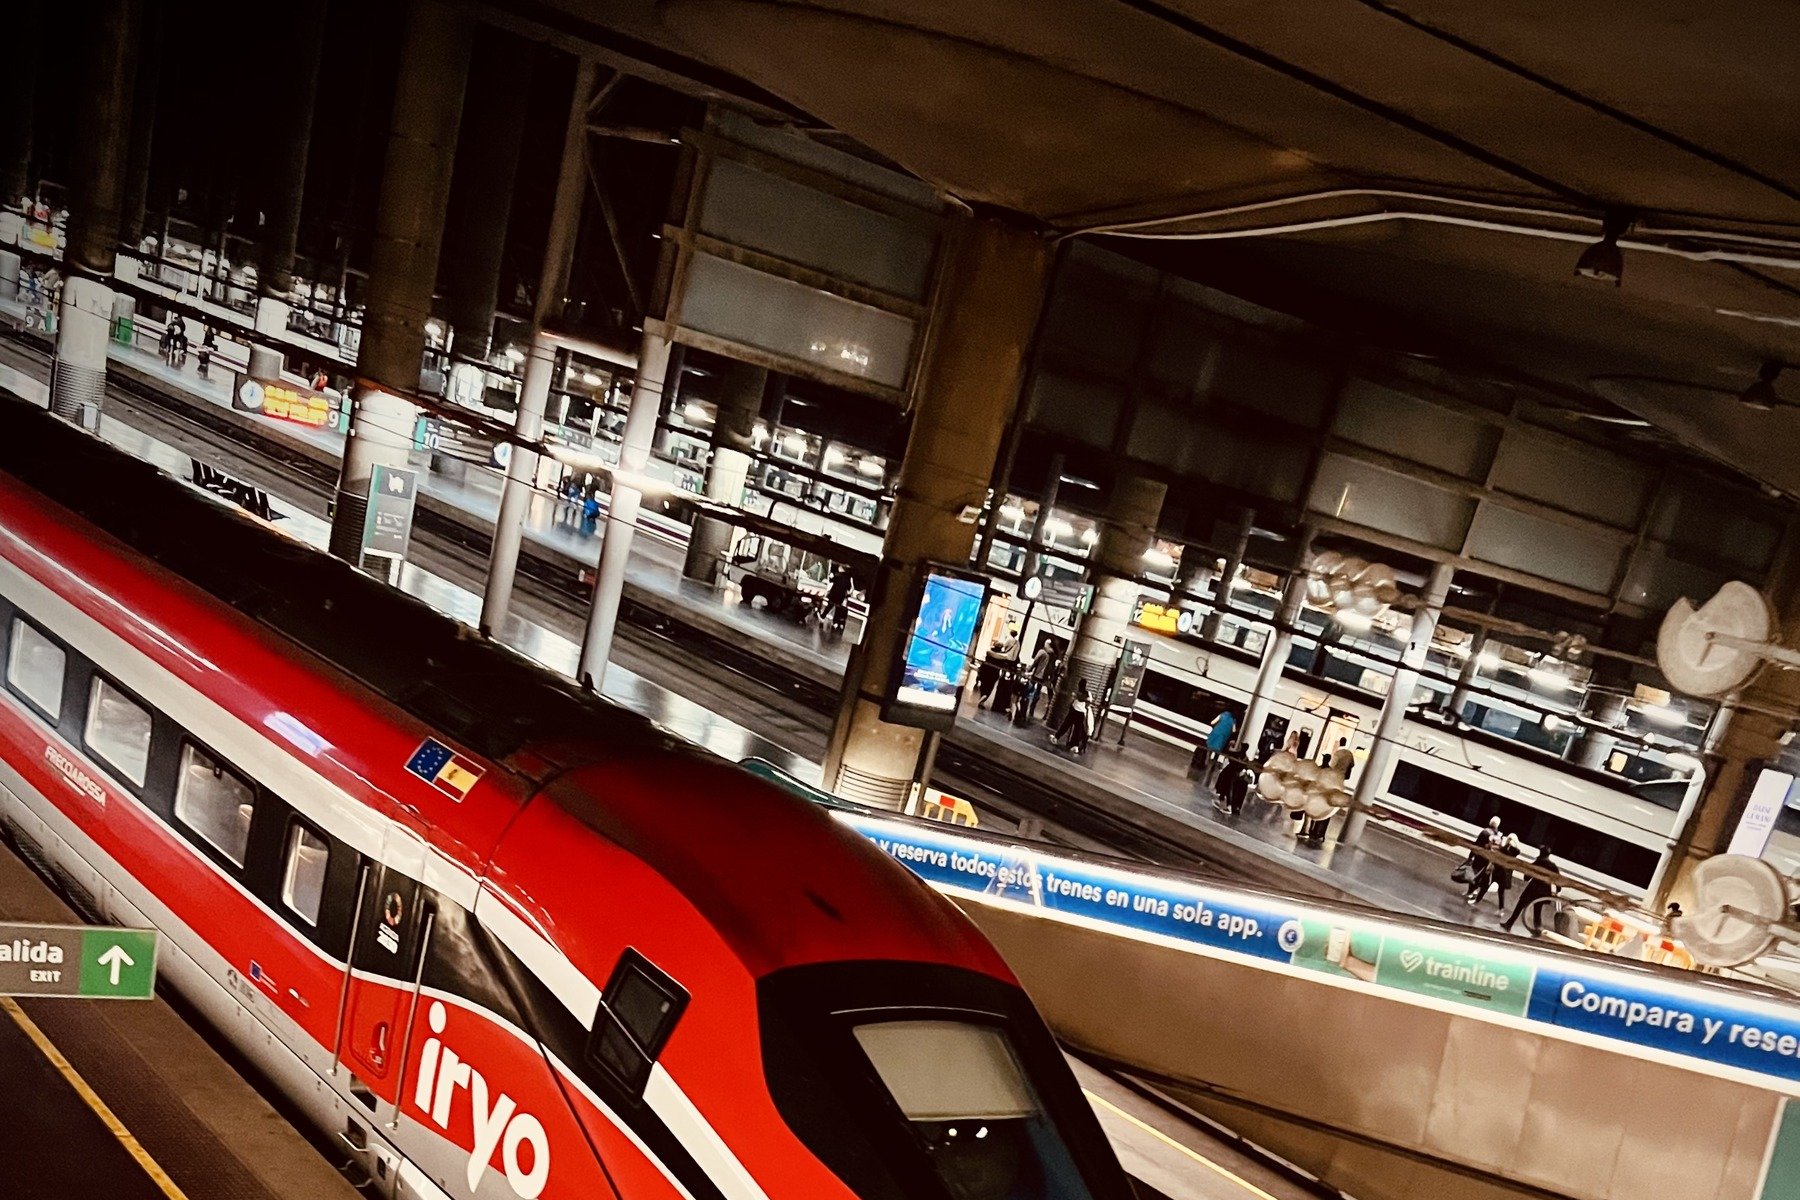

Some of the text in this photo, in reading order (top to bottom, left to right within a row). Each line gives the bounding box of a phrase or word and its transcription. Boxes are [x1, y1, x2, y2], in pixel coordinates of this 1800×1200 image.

[328, 410, 339, 428] 9
[424, 432, 440, 450] 10
[1075, 593, 1087, 610] 11
[892, 842, 948, 868] reserva
[951, 851, 996, 878] todos
[1047, 872, 1102, 902] trenes
[1106, 889, 1129, 908] en
[1133, 894, 1169, 917] una
[1172, 901, 1213, 926] sola
[1217, 913, 1263, 940] app.
[30, 969, 62, 983] EXIT
[1425, 955, 1510, 991] trainline
[1560, 980, 1800, 1057] Compara y rese
[414, 1000, 551, 1200] iryo
